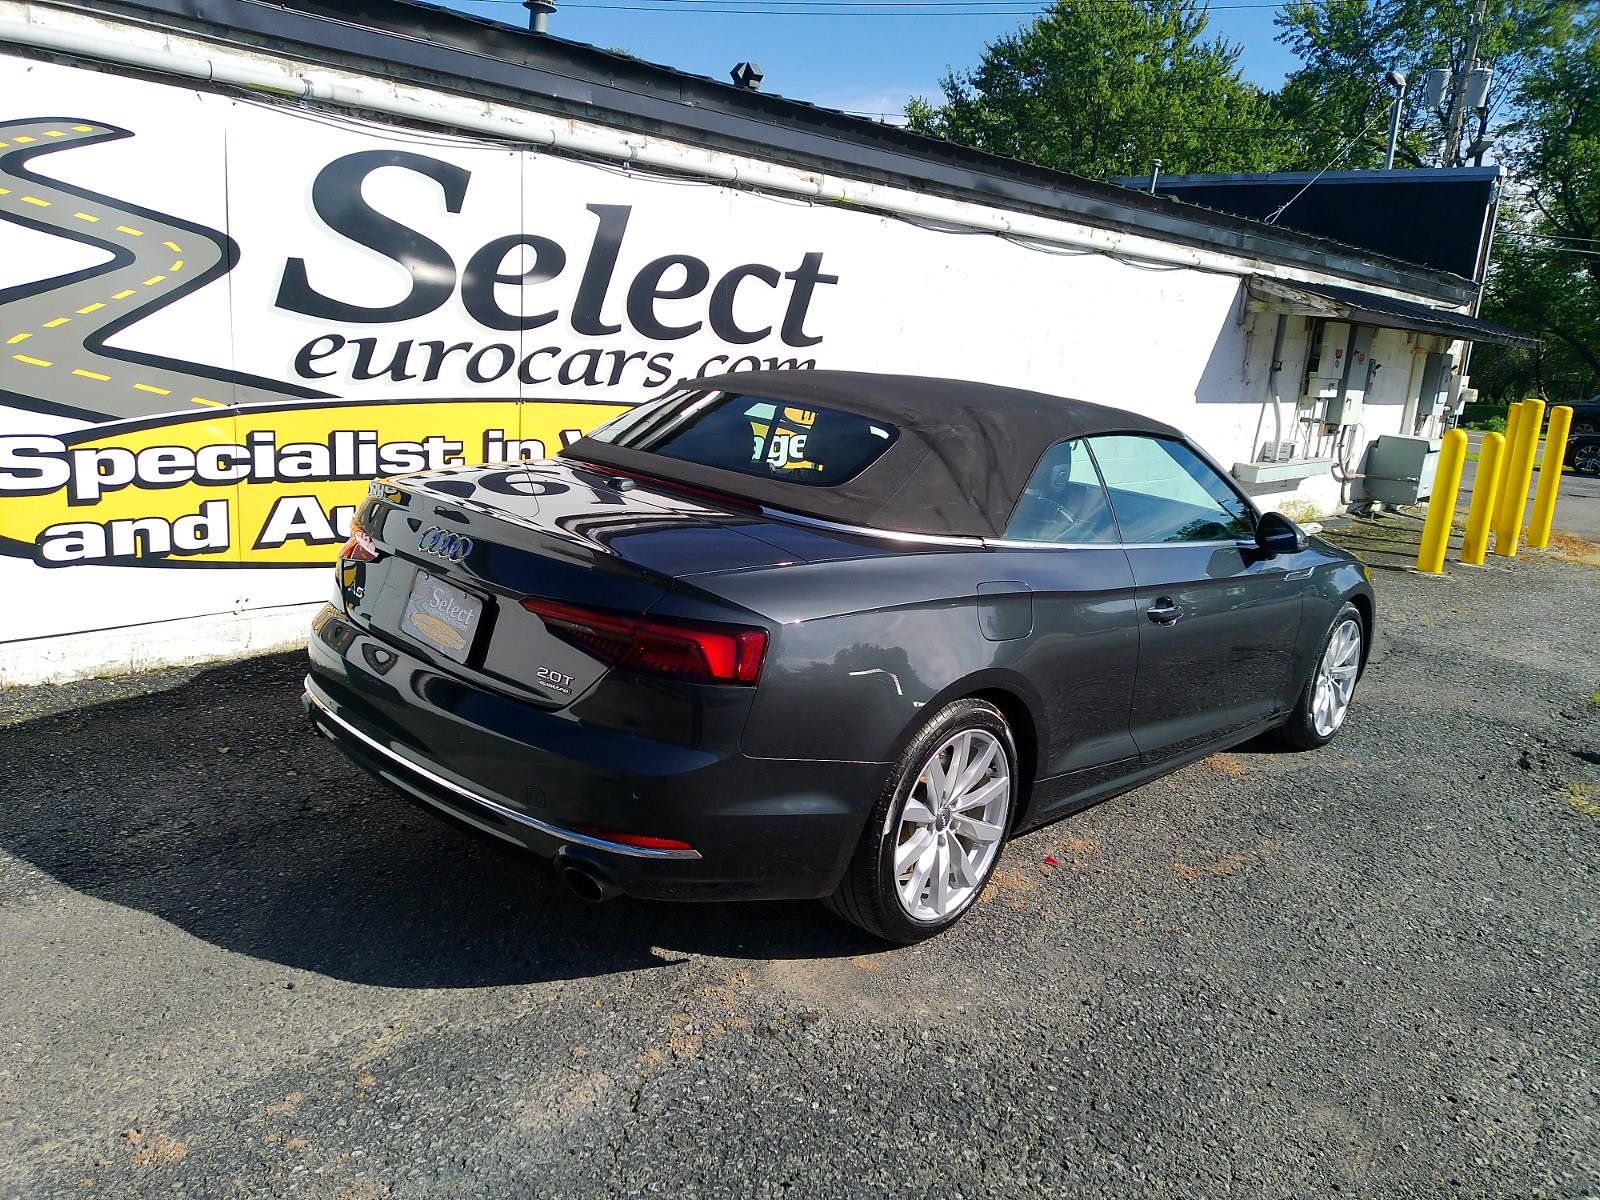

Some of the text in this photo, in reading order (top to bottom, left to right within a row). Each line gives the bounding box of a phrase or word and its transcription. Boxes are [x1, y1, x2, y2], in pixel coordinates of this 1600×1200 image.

[274, 149, 838, 347] Select
[0, 429, 546, 506] Specialist in
[35, 499, 230, 568] and
[429, 587, 474, 625] Select
